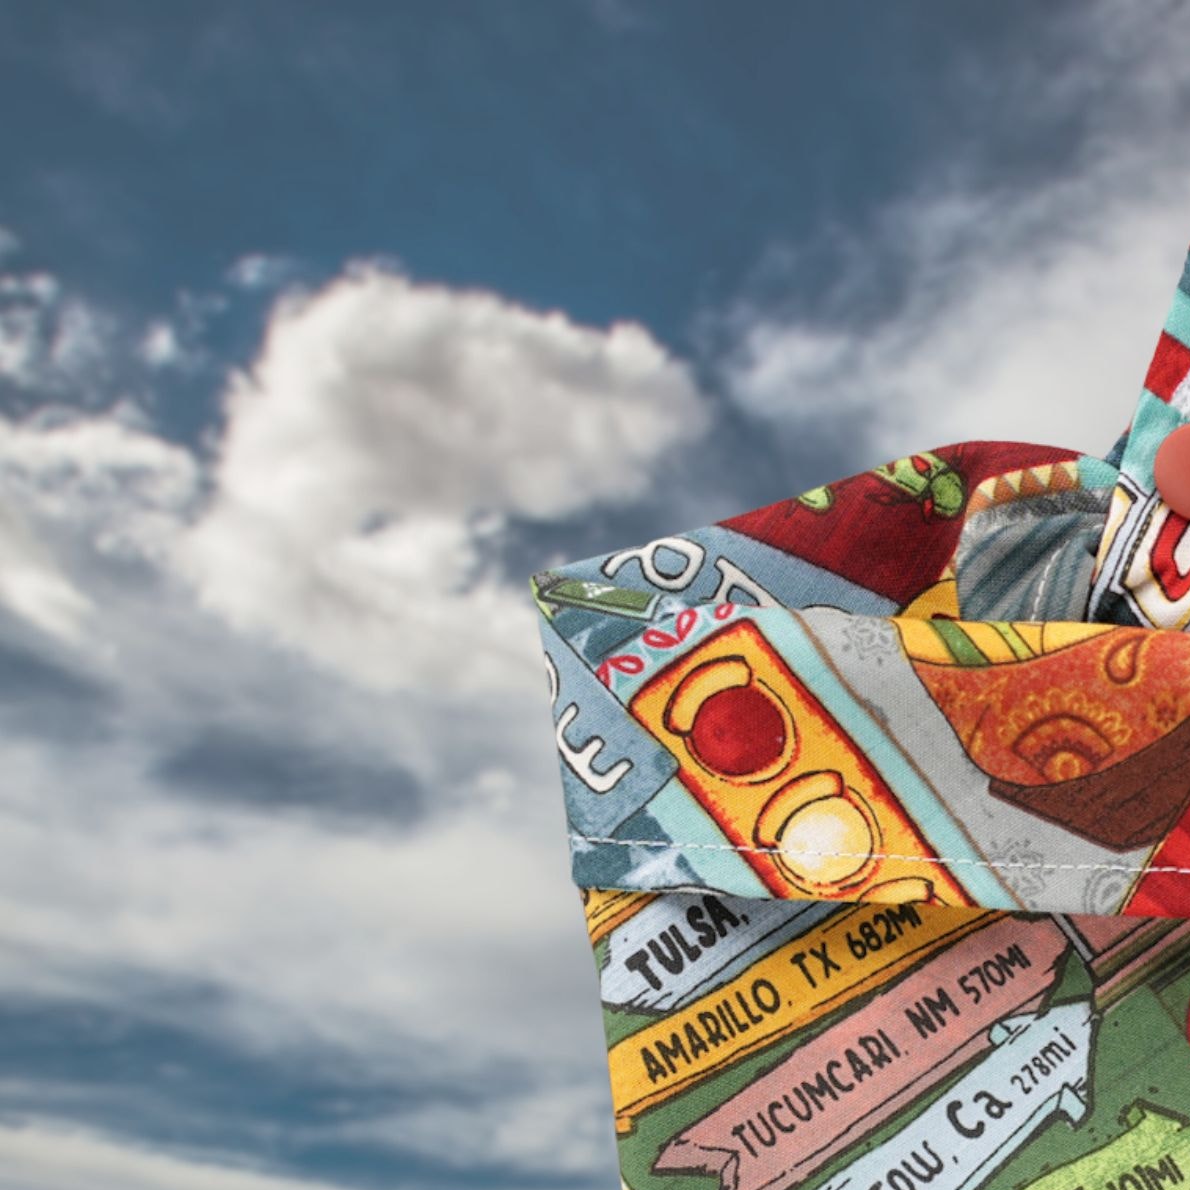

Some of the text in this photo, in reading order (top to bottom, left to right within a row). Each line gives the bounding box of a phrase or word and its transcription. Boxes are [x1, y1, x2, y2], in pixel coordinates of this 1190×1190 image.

[790, 942, 841, 989] TX
[903, 987, 961, 1040] NM
[956, 943, 1032, 1005] 570MI
[946, 1090, 1013, 1139] Ca
